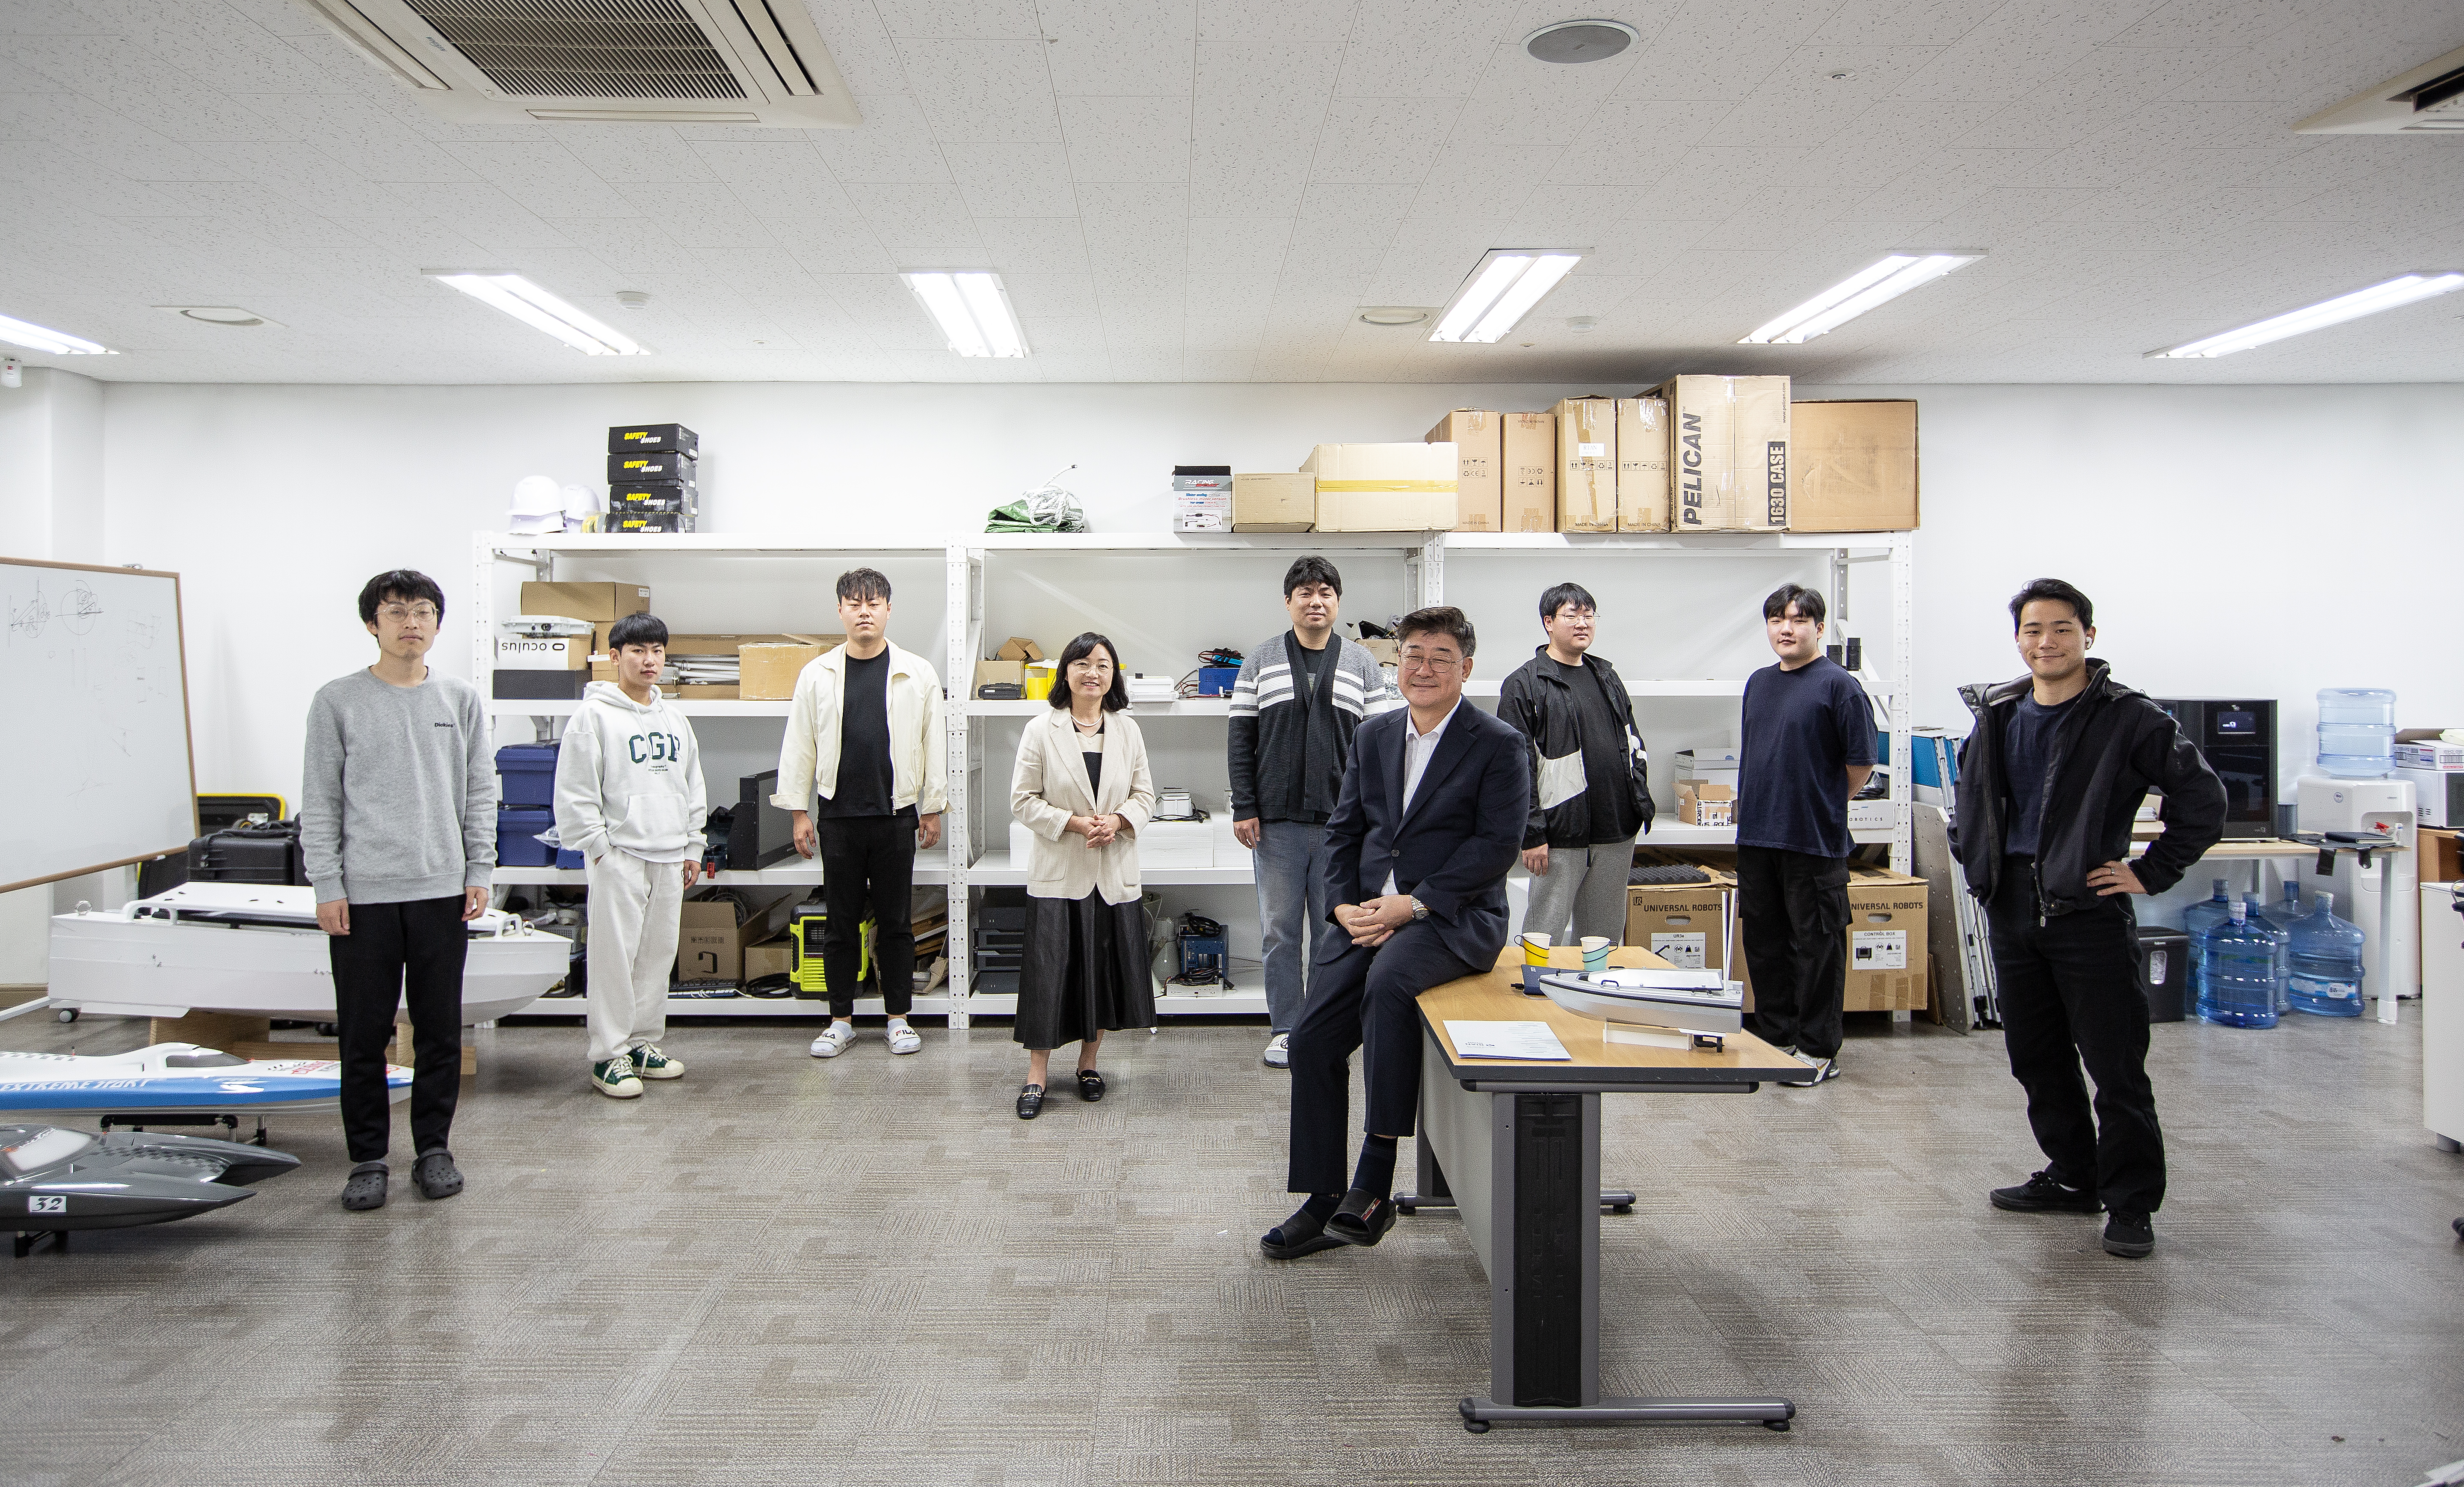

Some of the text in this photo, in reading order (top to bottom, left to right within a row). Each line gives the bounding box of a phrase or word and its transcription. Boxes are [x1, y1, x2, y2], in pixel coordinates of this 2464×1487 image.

[624, 432, 648, 440] SAFETY
[624, 460, 649, 469] SAFETY
[1683, 413, 1702, 525] PELICAN
[1770, 446, 1784, 523] 1630 CASE
[502, 642, 547, 653] oculus
[0, 1081, 93, 1091] EXTREME
[32, 1197, 63, 1211] 32
